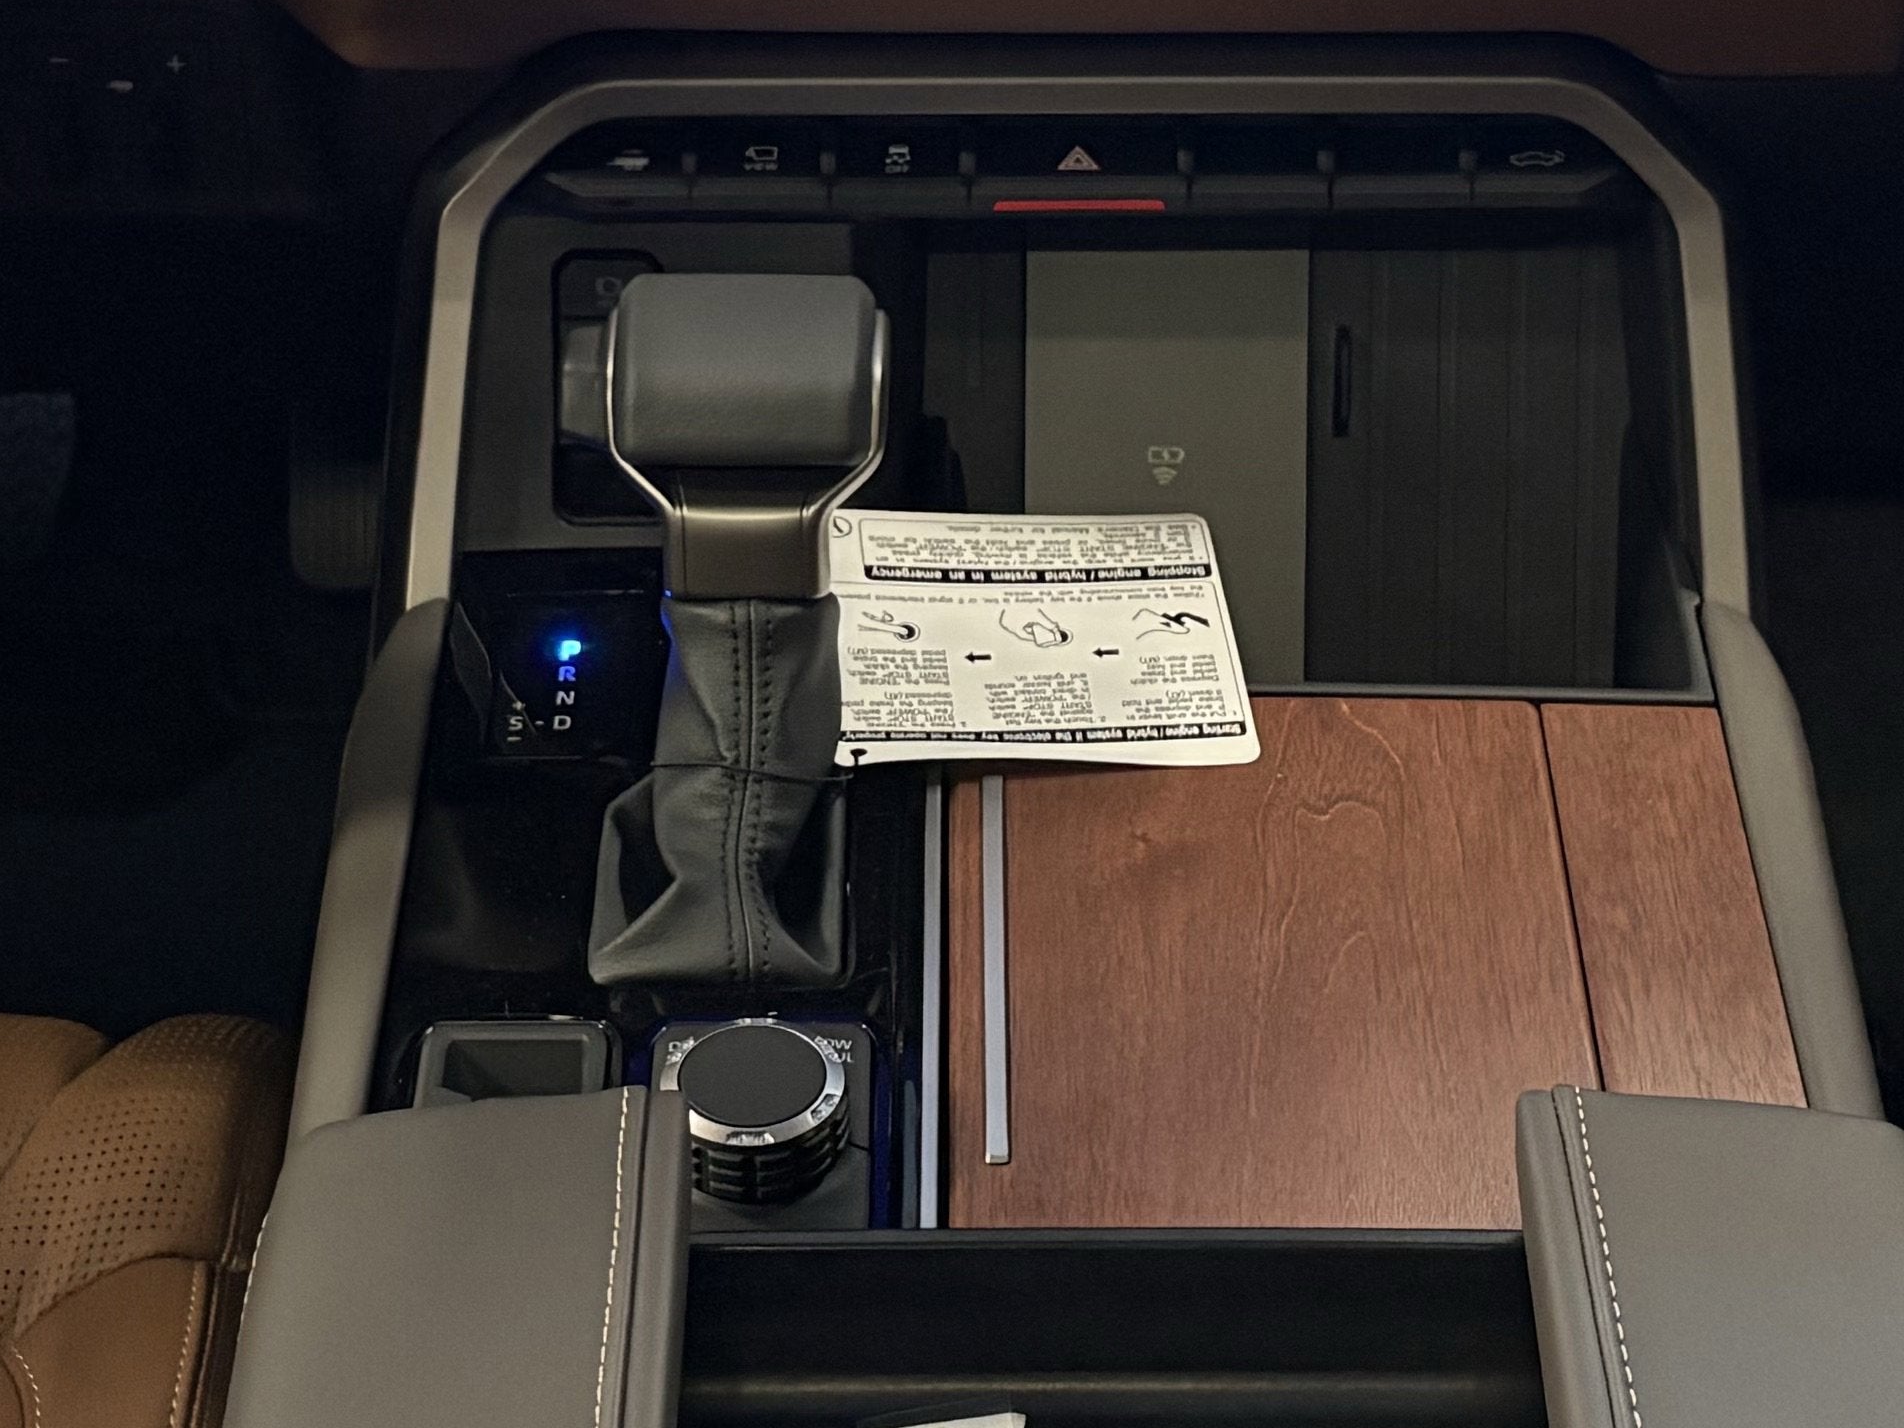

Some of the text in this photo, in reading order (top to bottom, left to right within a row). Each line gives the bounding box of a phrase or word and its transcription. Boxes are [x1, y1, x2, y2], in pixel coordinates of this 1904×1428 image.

[871, 566, 942, 579] emergency
[949, 571, 965, 580] an
[971, 572, 984, 582] in
[991, 570, 1038, 582] system
[1045, 570, 1086, 582] hybrid
[1098, 568, 1141, 580] engine
[1148, 565, 1205, 578] Stopping
[558, 639, 582, 661] P
[557, 665, 577, 682] R
[555, 689, 576, 706] N
[507, 715, 572, 731] S D
[1086, 726, 1122, 740] system
